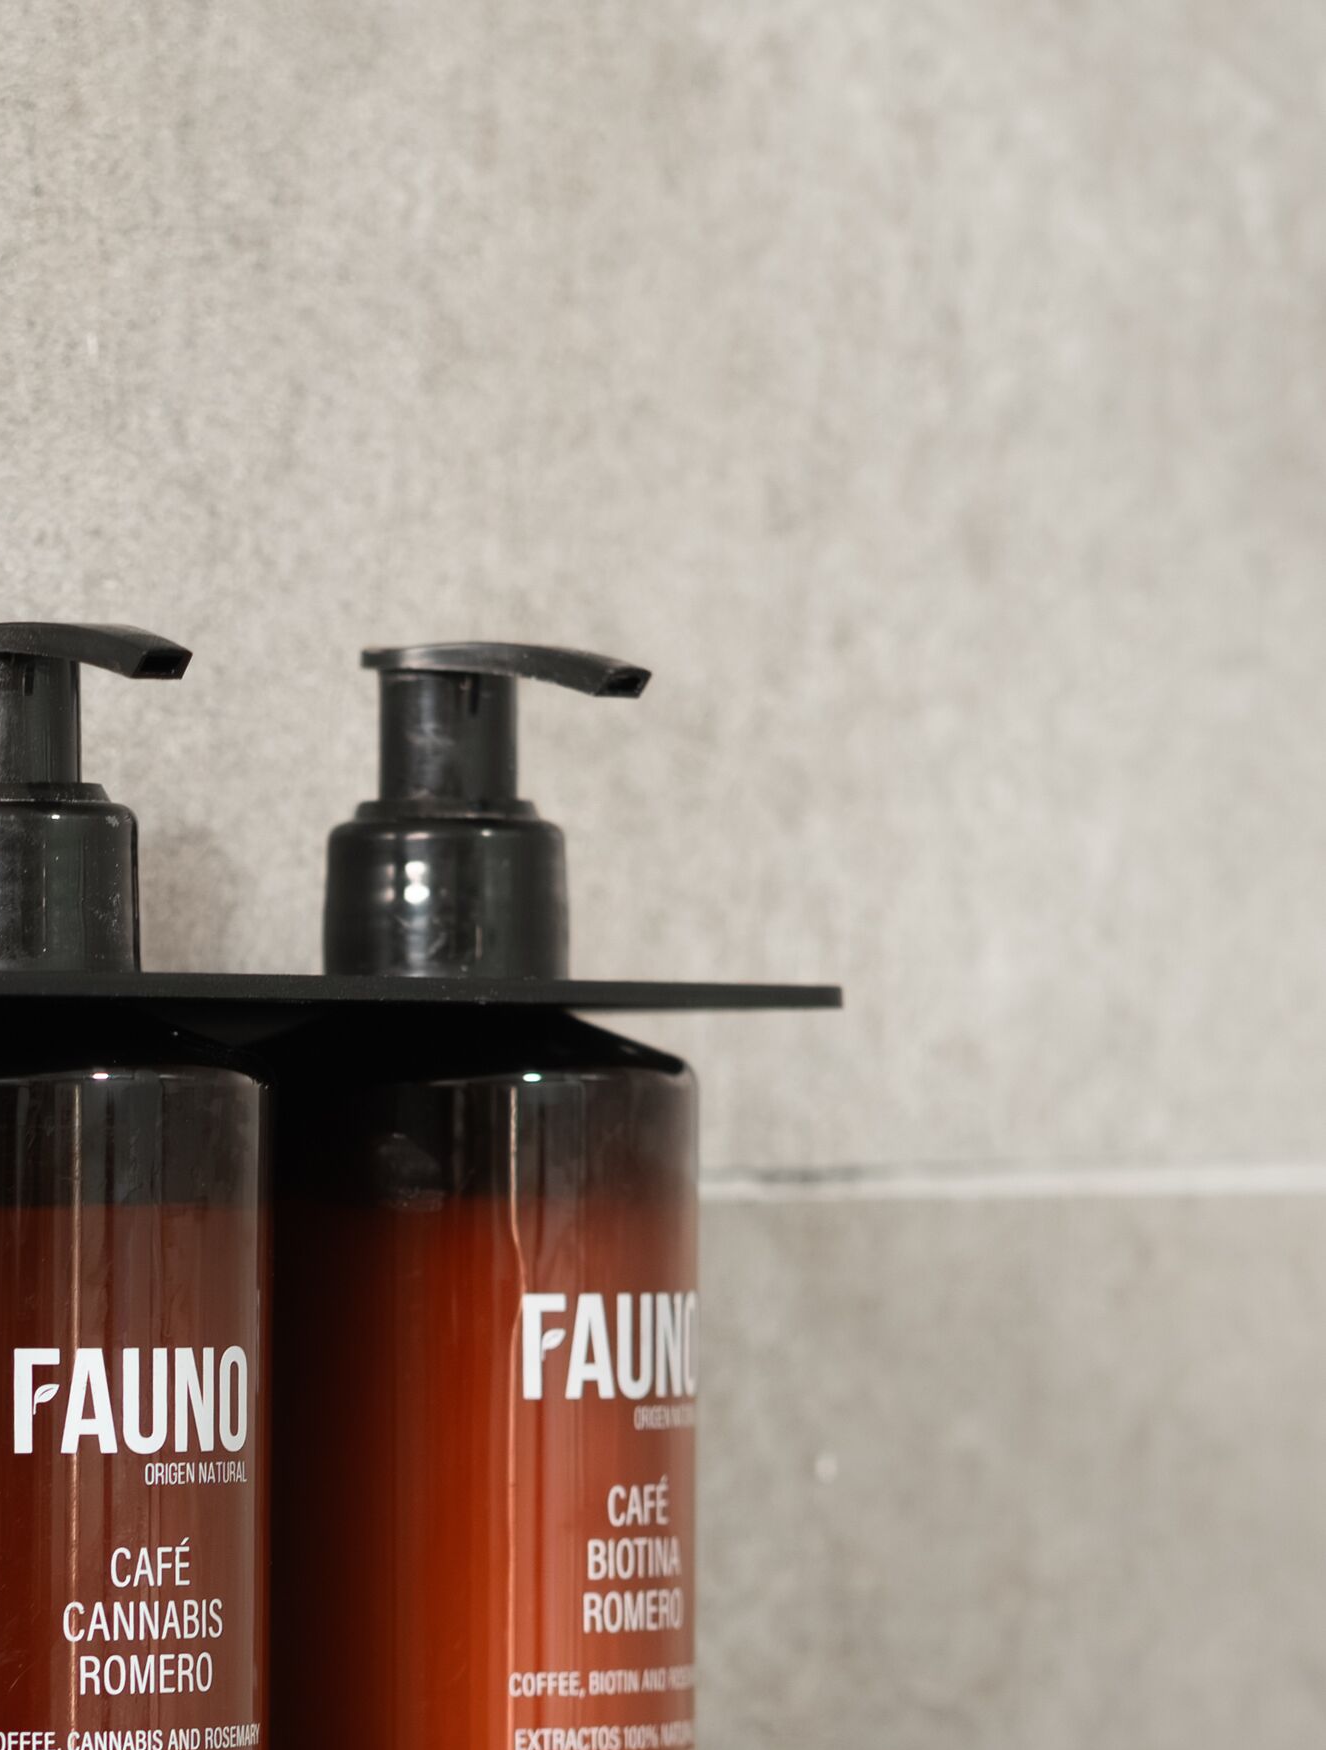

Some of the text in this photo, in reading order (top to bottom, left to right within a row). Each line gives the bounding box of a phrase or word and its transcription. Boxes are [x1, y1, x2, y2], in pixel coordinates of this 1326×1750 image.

[13, 1345, 248, 1454] FAUNO
[144, 1460, 247, 1486] ORIGEN NATURAL
[607, 1474, 669, 1527] CAFÉ
[110, 1537, 190, 1588] CAFÉ
[587, 1536, 681, 1580] BIOTINA
[63, 1598, 223, 1642] CANNABIS
[583, 1587, 683, 1633] ROMERO
[79, 1651, 213, 1696] ROMERO
[508, 1671, 586, 1698] COFFEE,
[588, 1669, 639, 1695] BIOTIN
[641, 1667, 666, 1692] AND
[168, 1725, 201, 1750] AND
[205, 1721, 260, 1749] ROSEMARY
[623, 1723, 659, 1750] 100%
